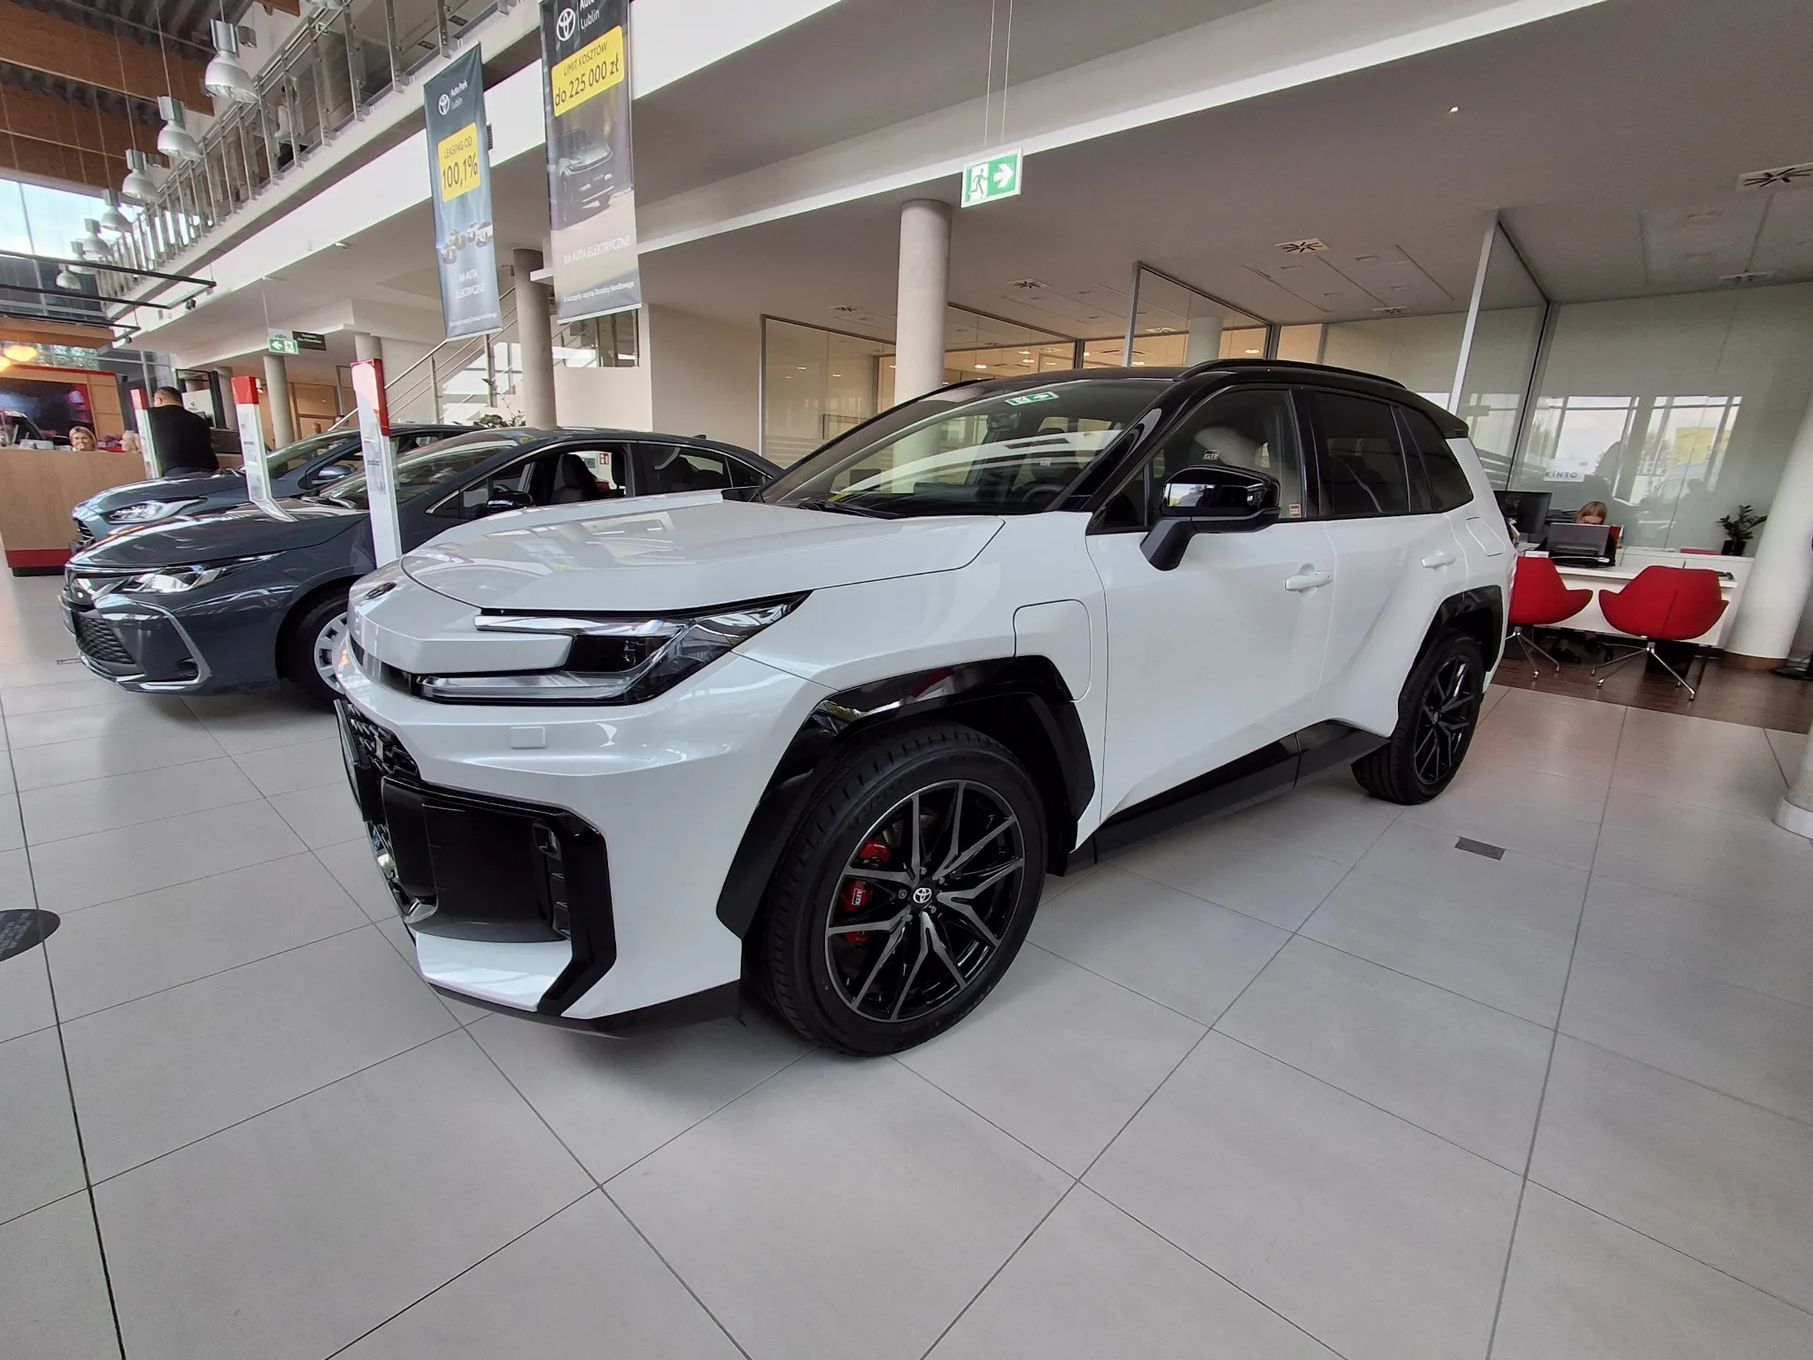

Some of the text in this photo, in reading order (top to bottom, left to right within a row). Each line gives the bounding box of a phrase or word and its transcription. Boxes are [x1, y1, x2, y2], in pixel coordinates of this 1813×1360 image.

[580, 9, 600, 30] Lublin
[555, 52, 619, 106] do 225 000 zł
[563, 59, 578, 76] LIMIT
[442, 152, 478, 190] 100,1%
